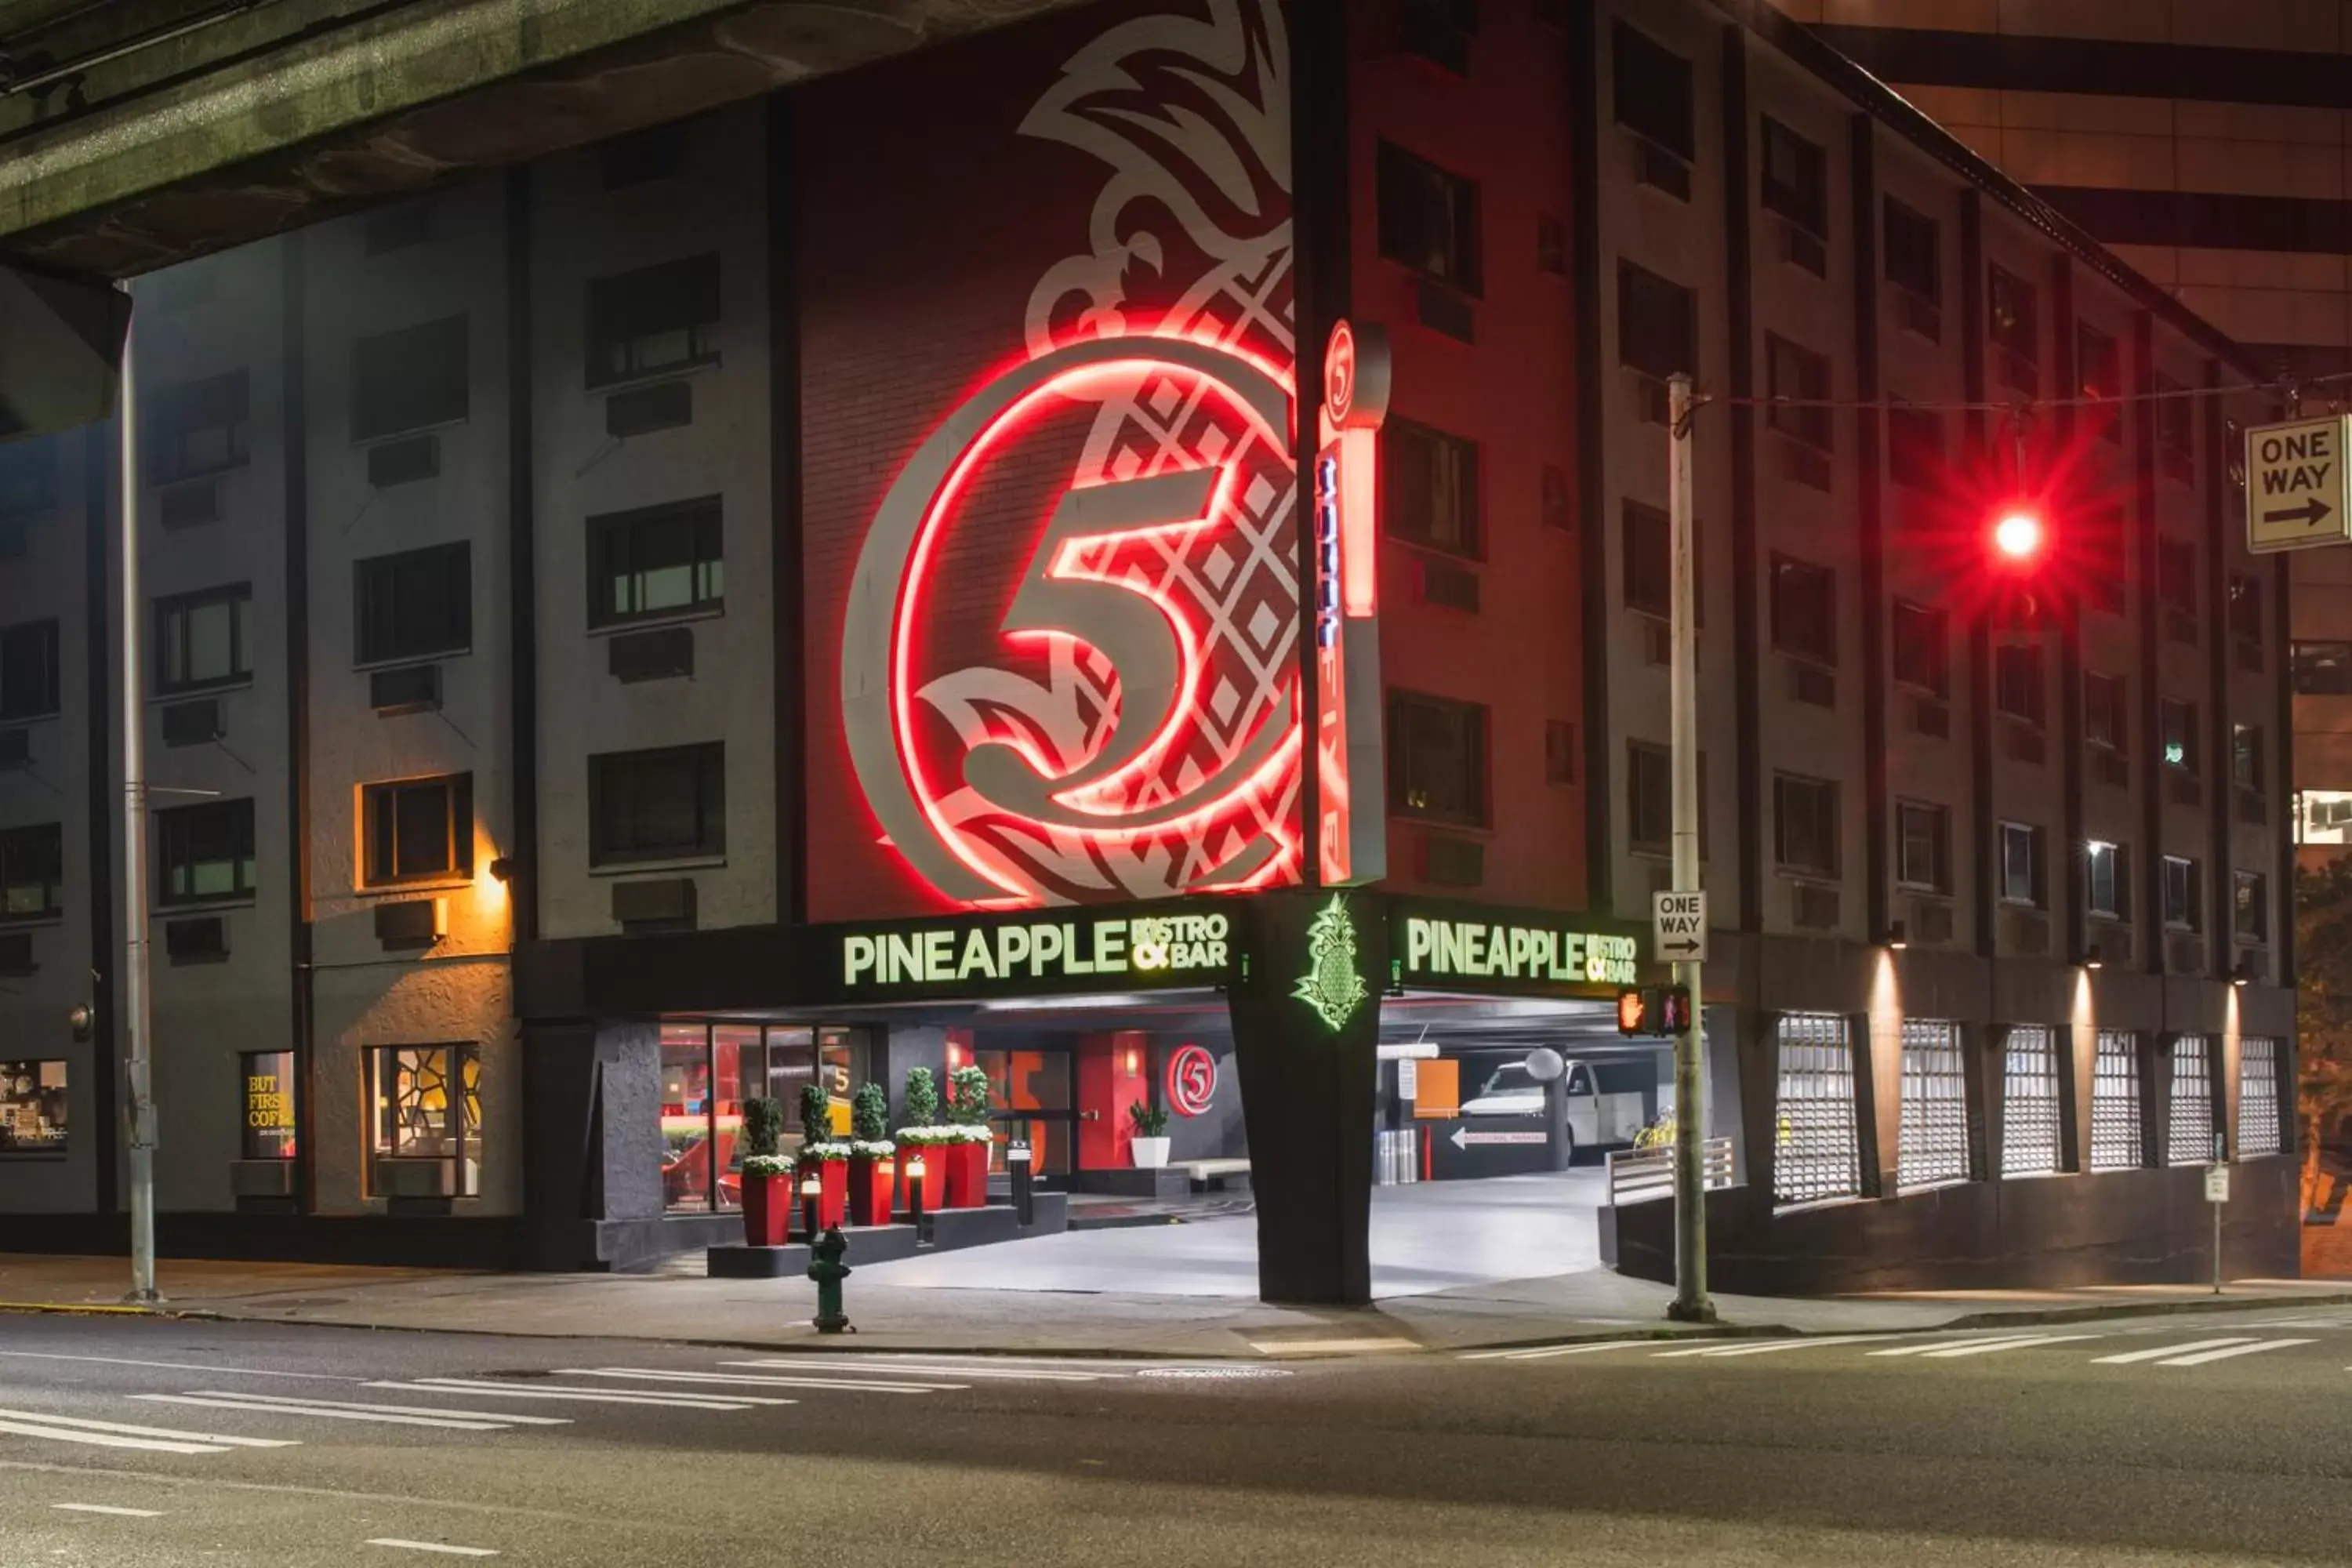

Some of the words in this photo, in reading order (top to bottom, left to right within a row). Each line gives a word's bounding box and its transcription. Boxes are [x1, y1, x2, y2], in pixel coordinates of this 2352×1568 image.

[2261, 431, 2330, 464] ONE
[2262, 463, 2332, 495] WAY
[1660, 897, 1700, 914] ONE
[1660, 916, 1700, 934] WAY
[844, 920, 1128, 986] PINEAPPLE
[1131, 913, 1229, 946] BISTRO
[1132, 942, 1169, 971] &
[1170, 940, 1229, 969] BAR
[1407, 917, 1585, 982] PINEAPPLE
[1606, 959, 1637, 985] BAR
[248, 1076, 277, 1092] BUT
[835, 1066, 849, 1092] 5
[248, 1092, 291, 1109] FIRS
